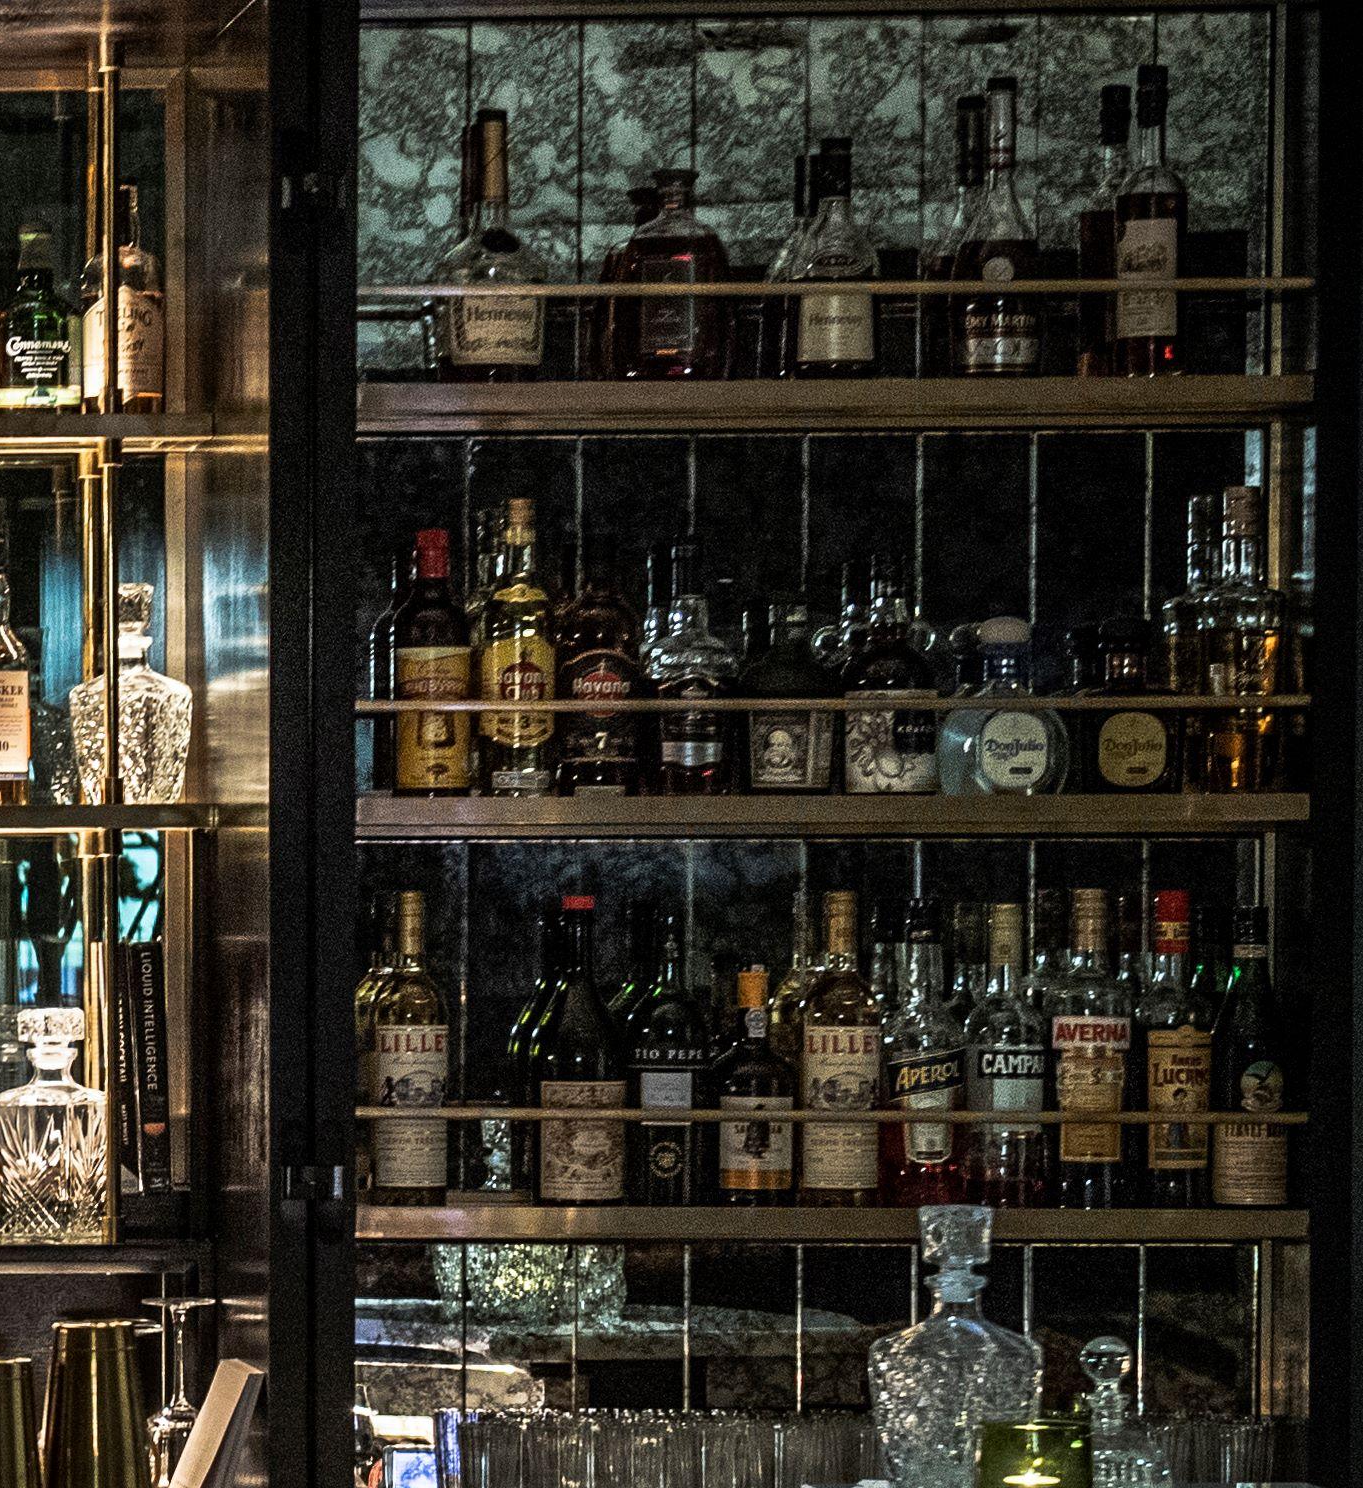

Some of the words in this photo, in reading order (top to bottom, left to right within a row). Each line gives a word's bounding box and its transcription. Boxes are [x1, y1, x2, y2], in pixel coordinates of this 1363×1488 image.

[594, 731, 610, 750] 7
[140, 951, 153, 997] LIQUID
[1054, 1022, 1128, 1042] AVERNA
[143, 999, 159, 1091] INTELLIGENCE
[380, 1033, 446, 1053] LILLE
[807, 1034, 876, 1054] LILLE
[635, 1049, 661, 1060] TIO
[894, 1060, 961, 1092] APEROL
